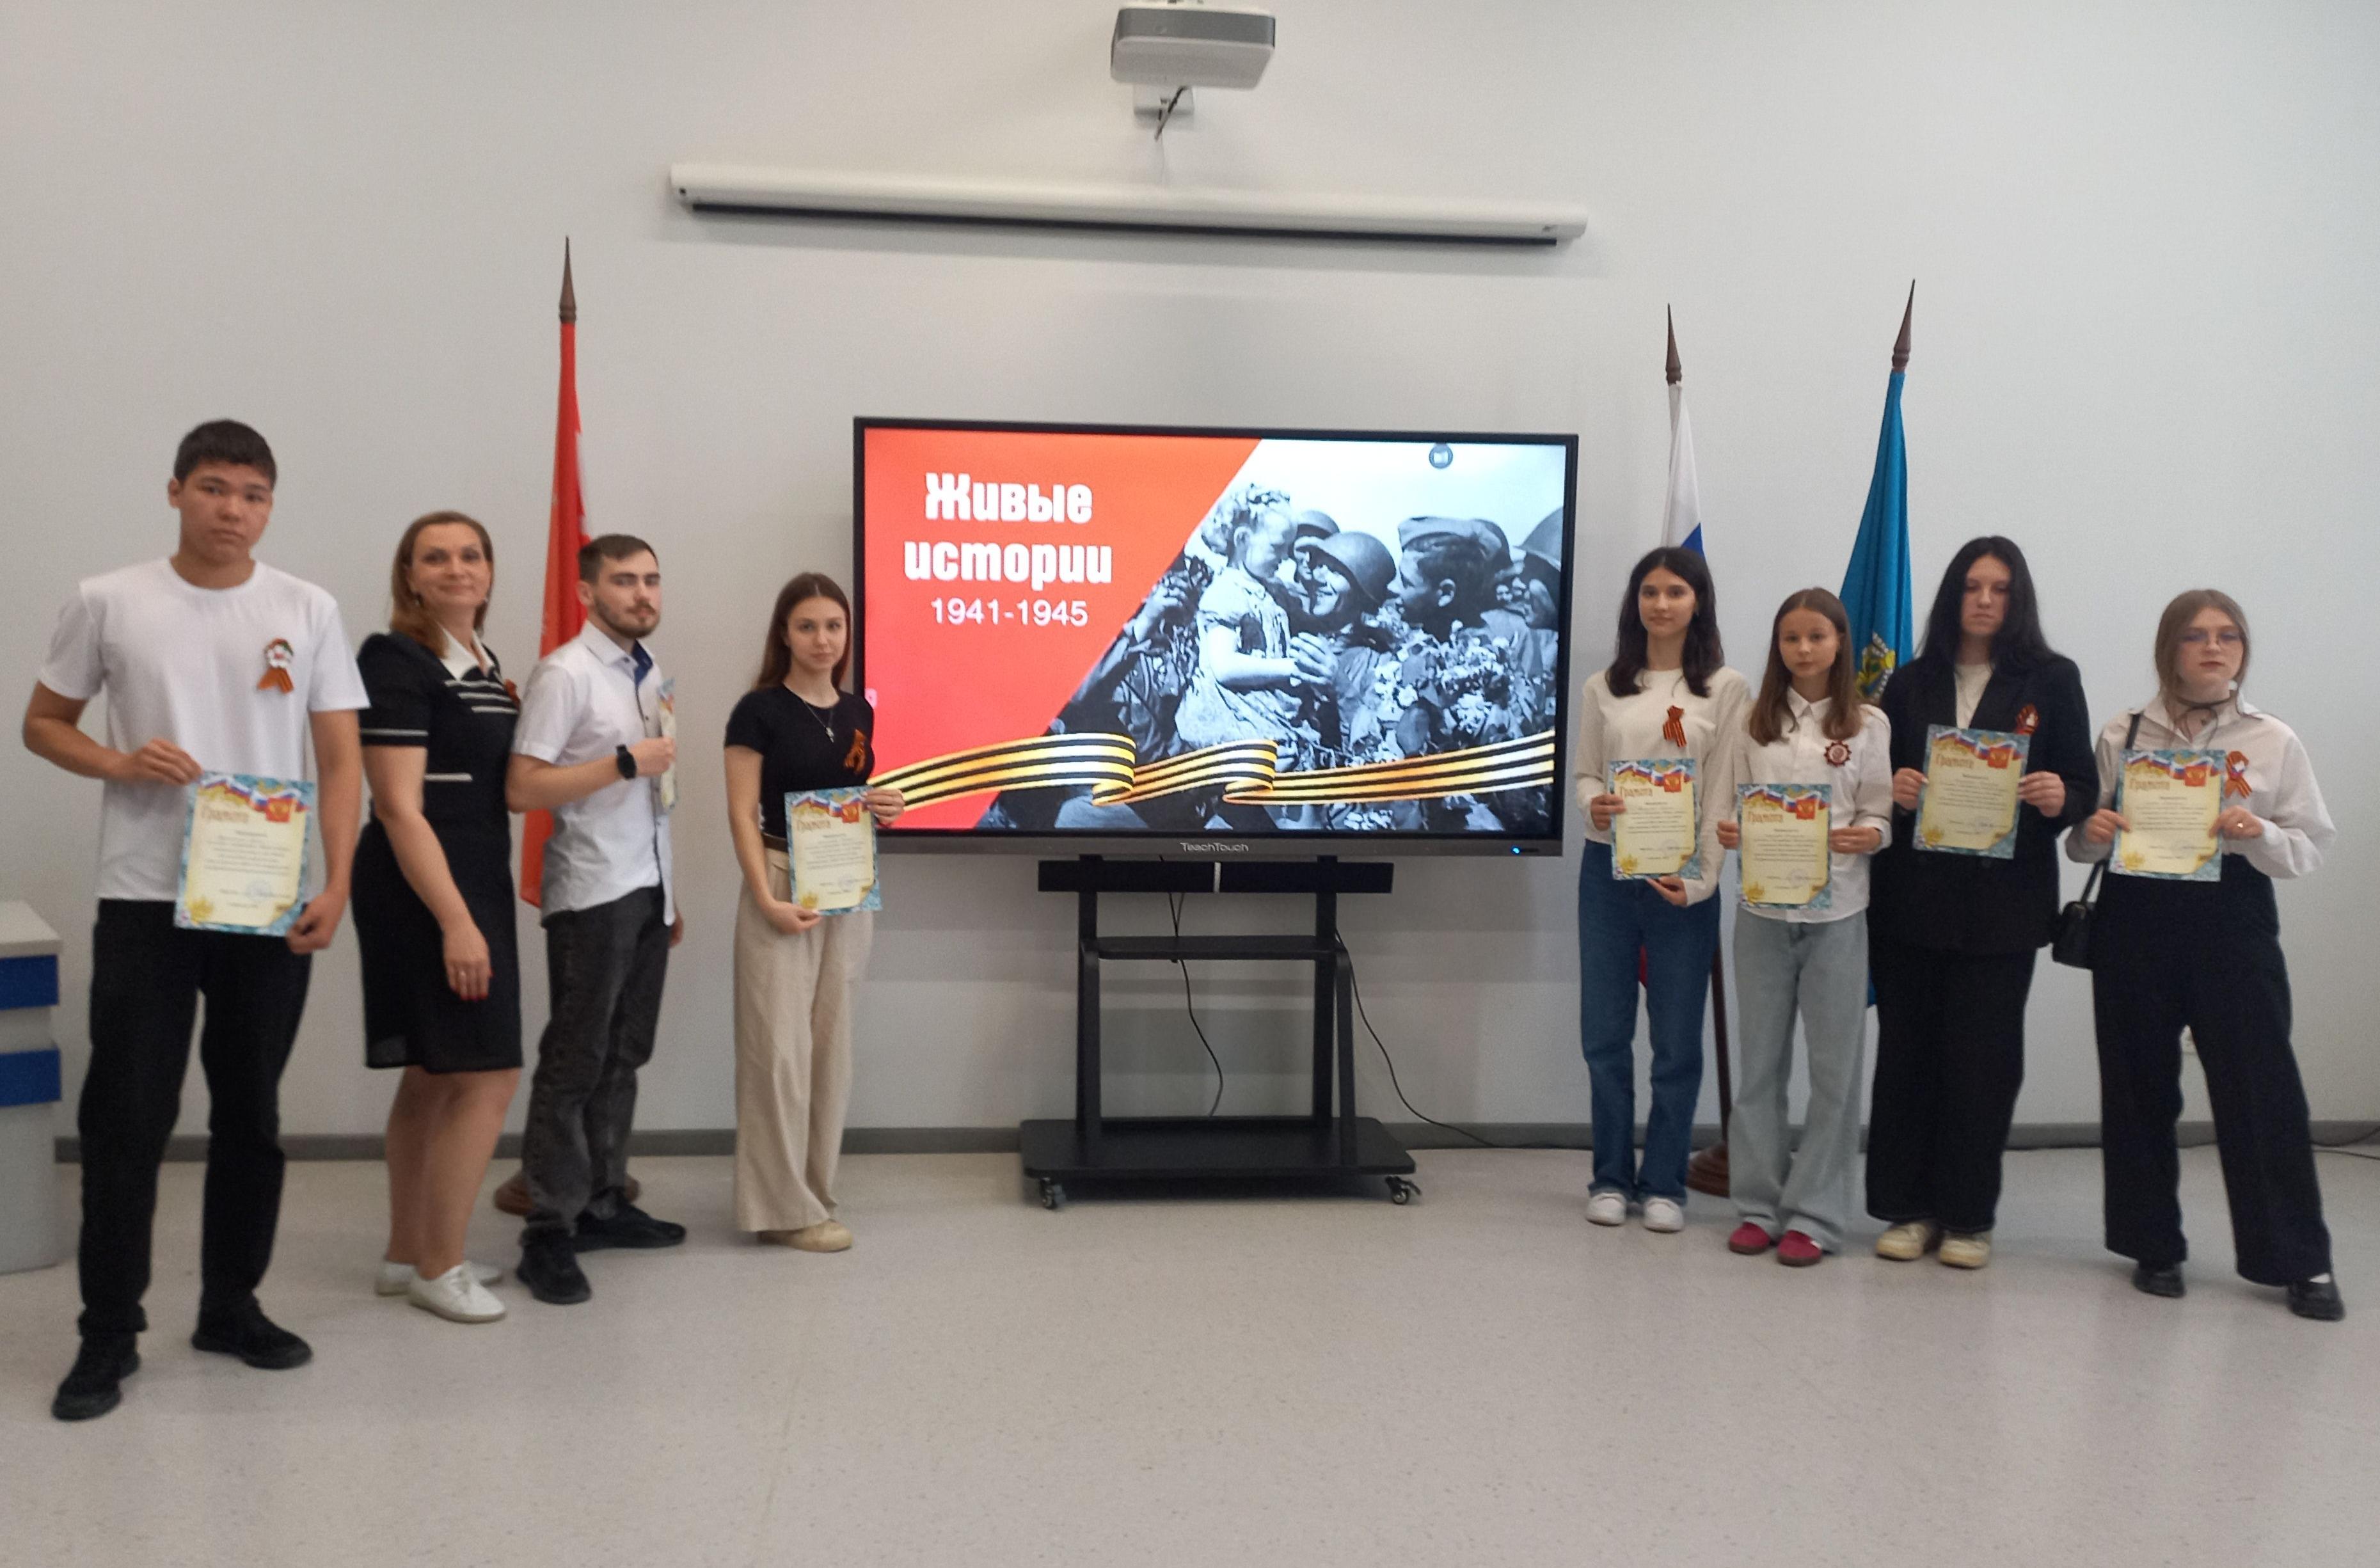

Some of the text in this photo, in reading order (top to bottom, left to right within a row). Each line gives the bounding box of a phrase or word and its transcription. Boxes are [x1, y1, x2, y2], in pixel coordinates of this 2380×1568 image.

[925, 472, 1093, 524] Живые
[904, 541, 1112, 591] истории
[931, 598, 1089, 627] 1941-1945
[1180, 842, 1249, 852] TeachTouch
